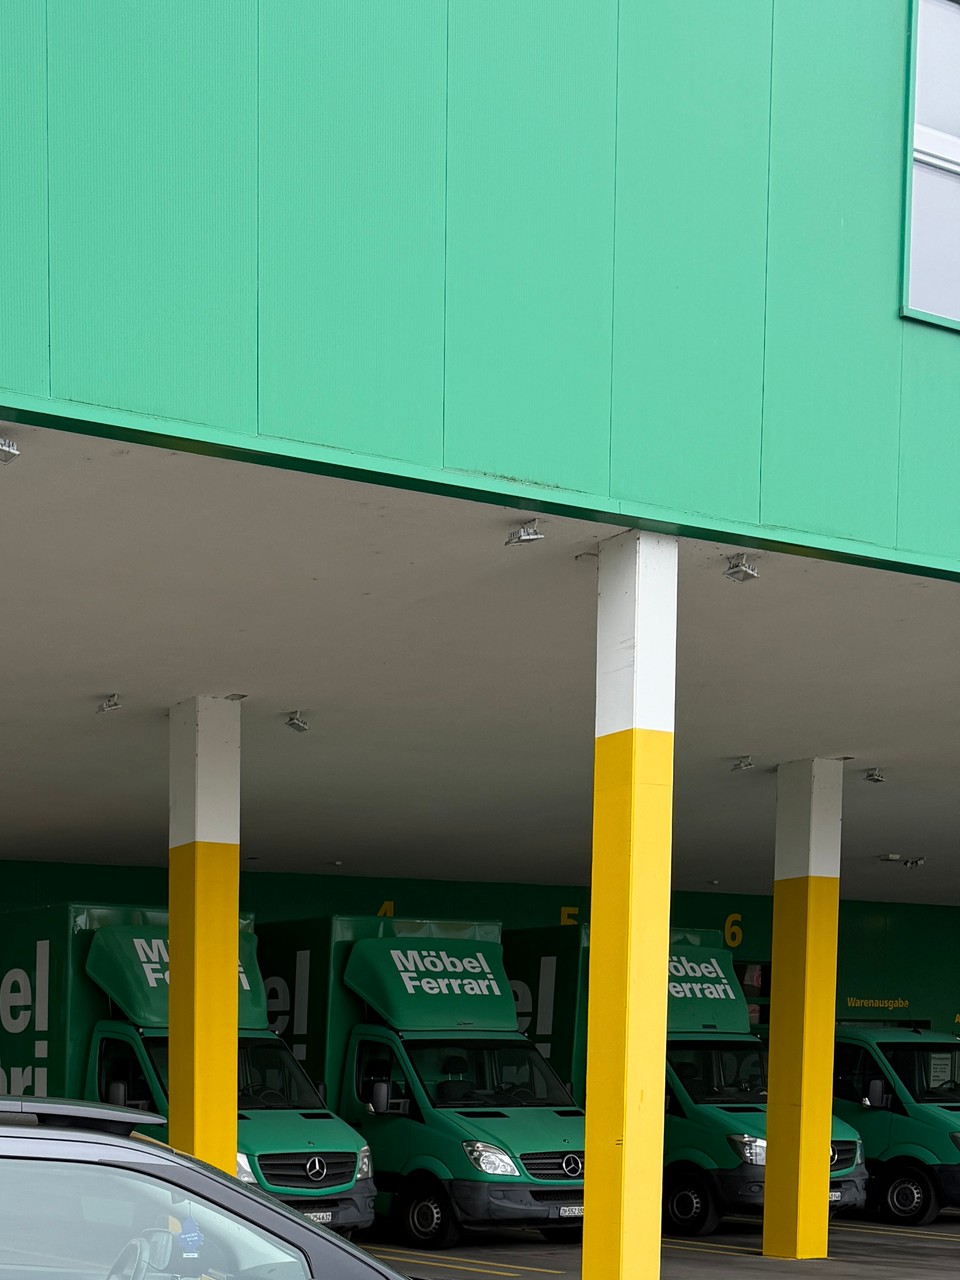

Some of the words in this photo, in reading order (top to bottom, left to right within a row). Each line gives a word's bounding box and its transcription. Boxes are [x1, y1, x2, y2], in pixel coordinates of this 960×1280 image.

[724, 913, 743, 948] 6
[390, 949, 492, 974] Möbel
[668, 955, 725, 979] öbel
[399, 972, 502, 996] Ferrari
[668, 980, 736, 1000] errari
[847, 997, 909, 1010] Warenausgabe
